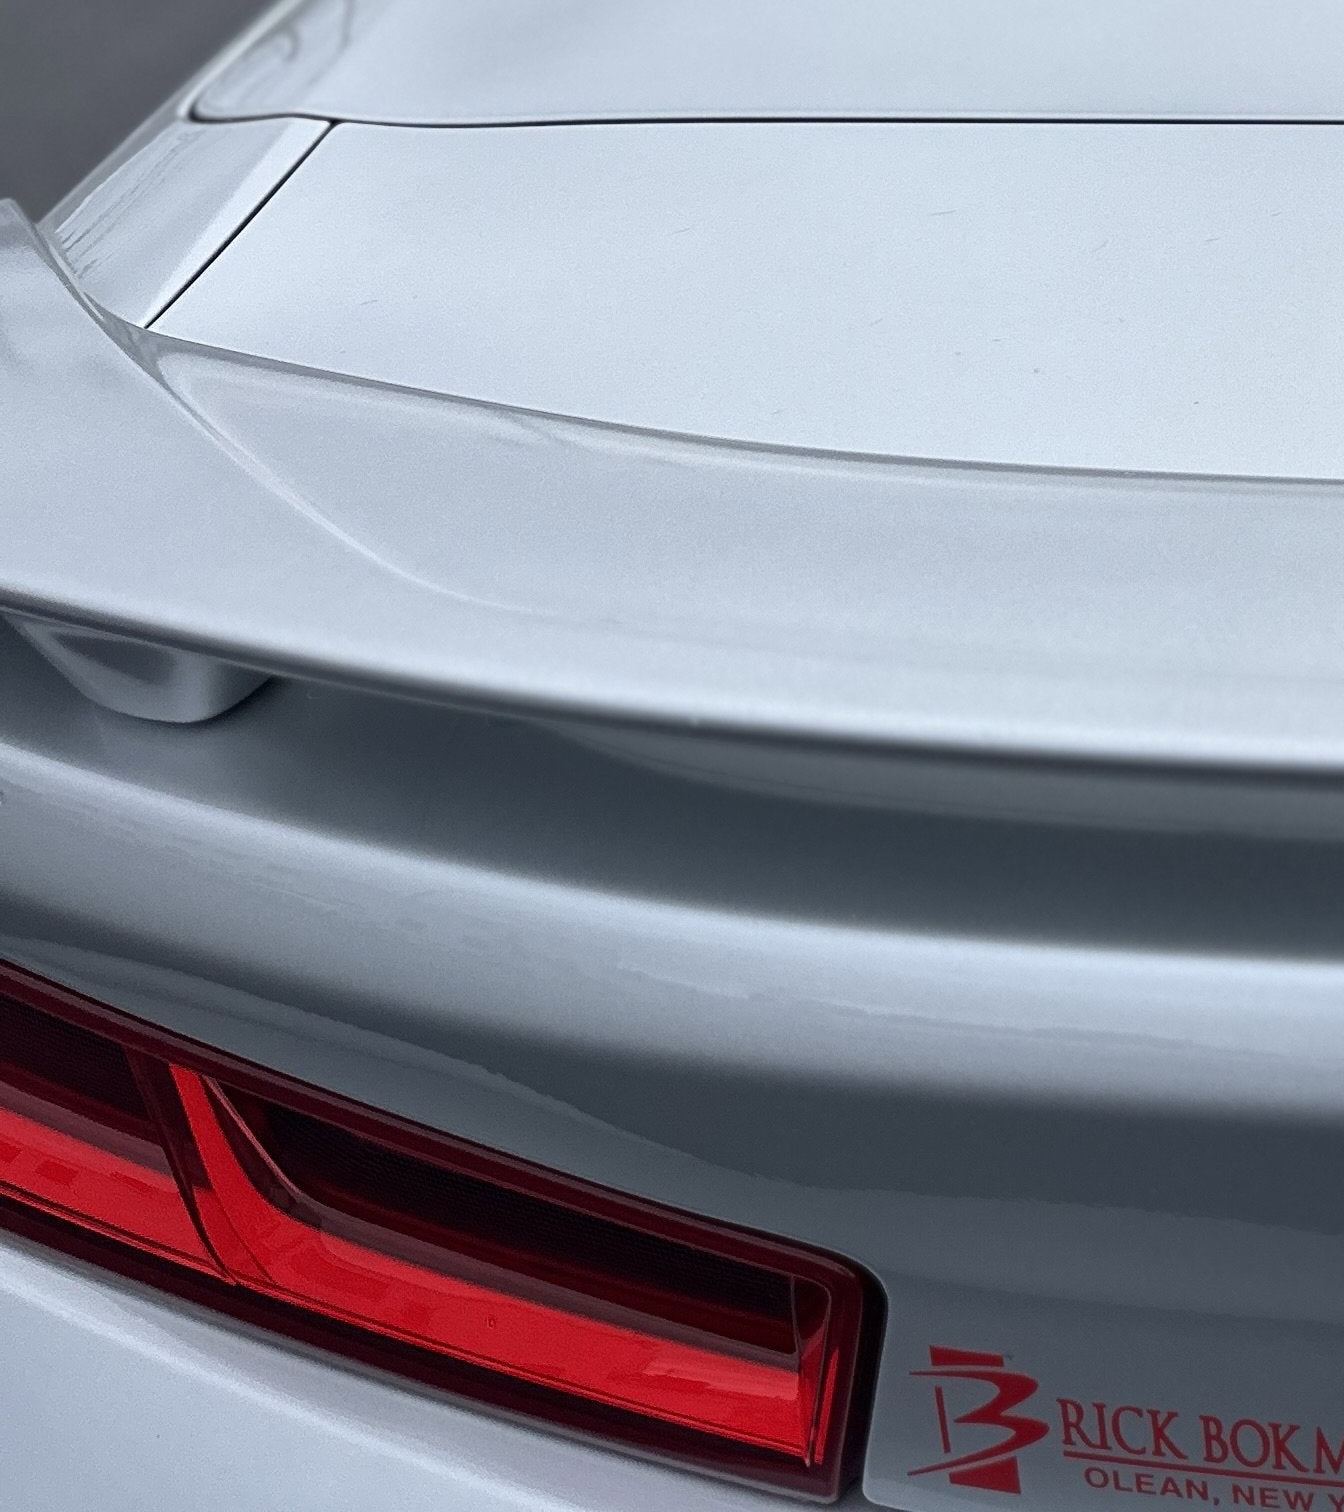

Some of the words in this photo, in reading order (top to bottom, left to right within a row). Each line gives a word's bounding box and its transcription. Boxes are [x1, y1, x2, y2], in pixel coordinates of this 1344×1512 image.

[1057, 1398, 1188, 1461] RICK
[1084, 1467, 1220, 1506] OLEAN,
[1232, 1484, 1315, 1512] NEW
